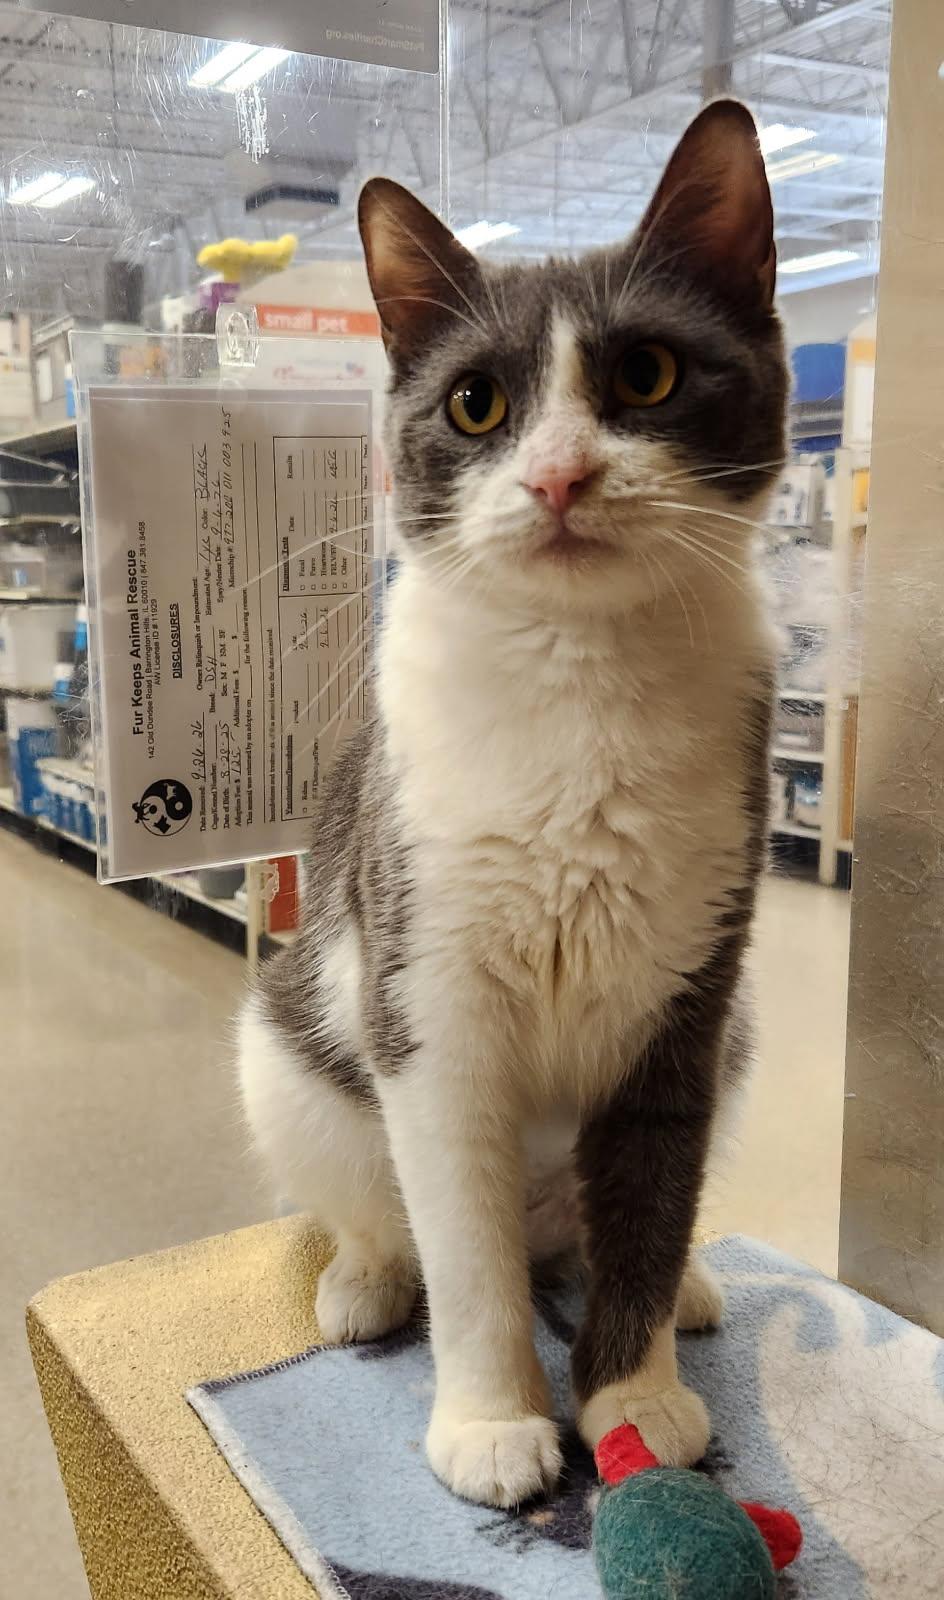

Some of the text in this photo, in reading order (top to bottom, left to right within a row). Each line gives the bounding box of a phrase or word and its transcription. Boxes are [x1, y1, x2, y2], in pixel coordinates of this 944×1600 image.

[264, 310, 348, 335] small pet
[150, 599, 158, 621] 11929
[126, 550, 144, 735] Fur Keeps Animal Rescue
[152, 631, 159, 640] ID
[170, 603, 182, 679] DISCLOSURES
[144, 636, 152, 673] Barrington
[154, 672, 160, 685] AW
[221, 672, 228, 680] M
[146, 701, 154, 729] Dundee
